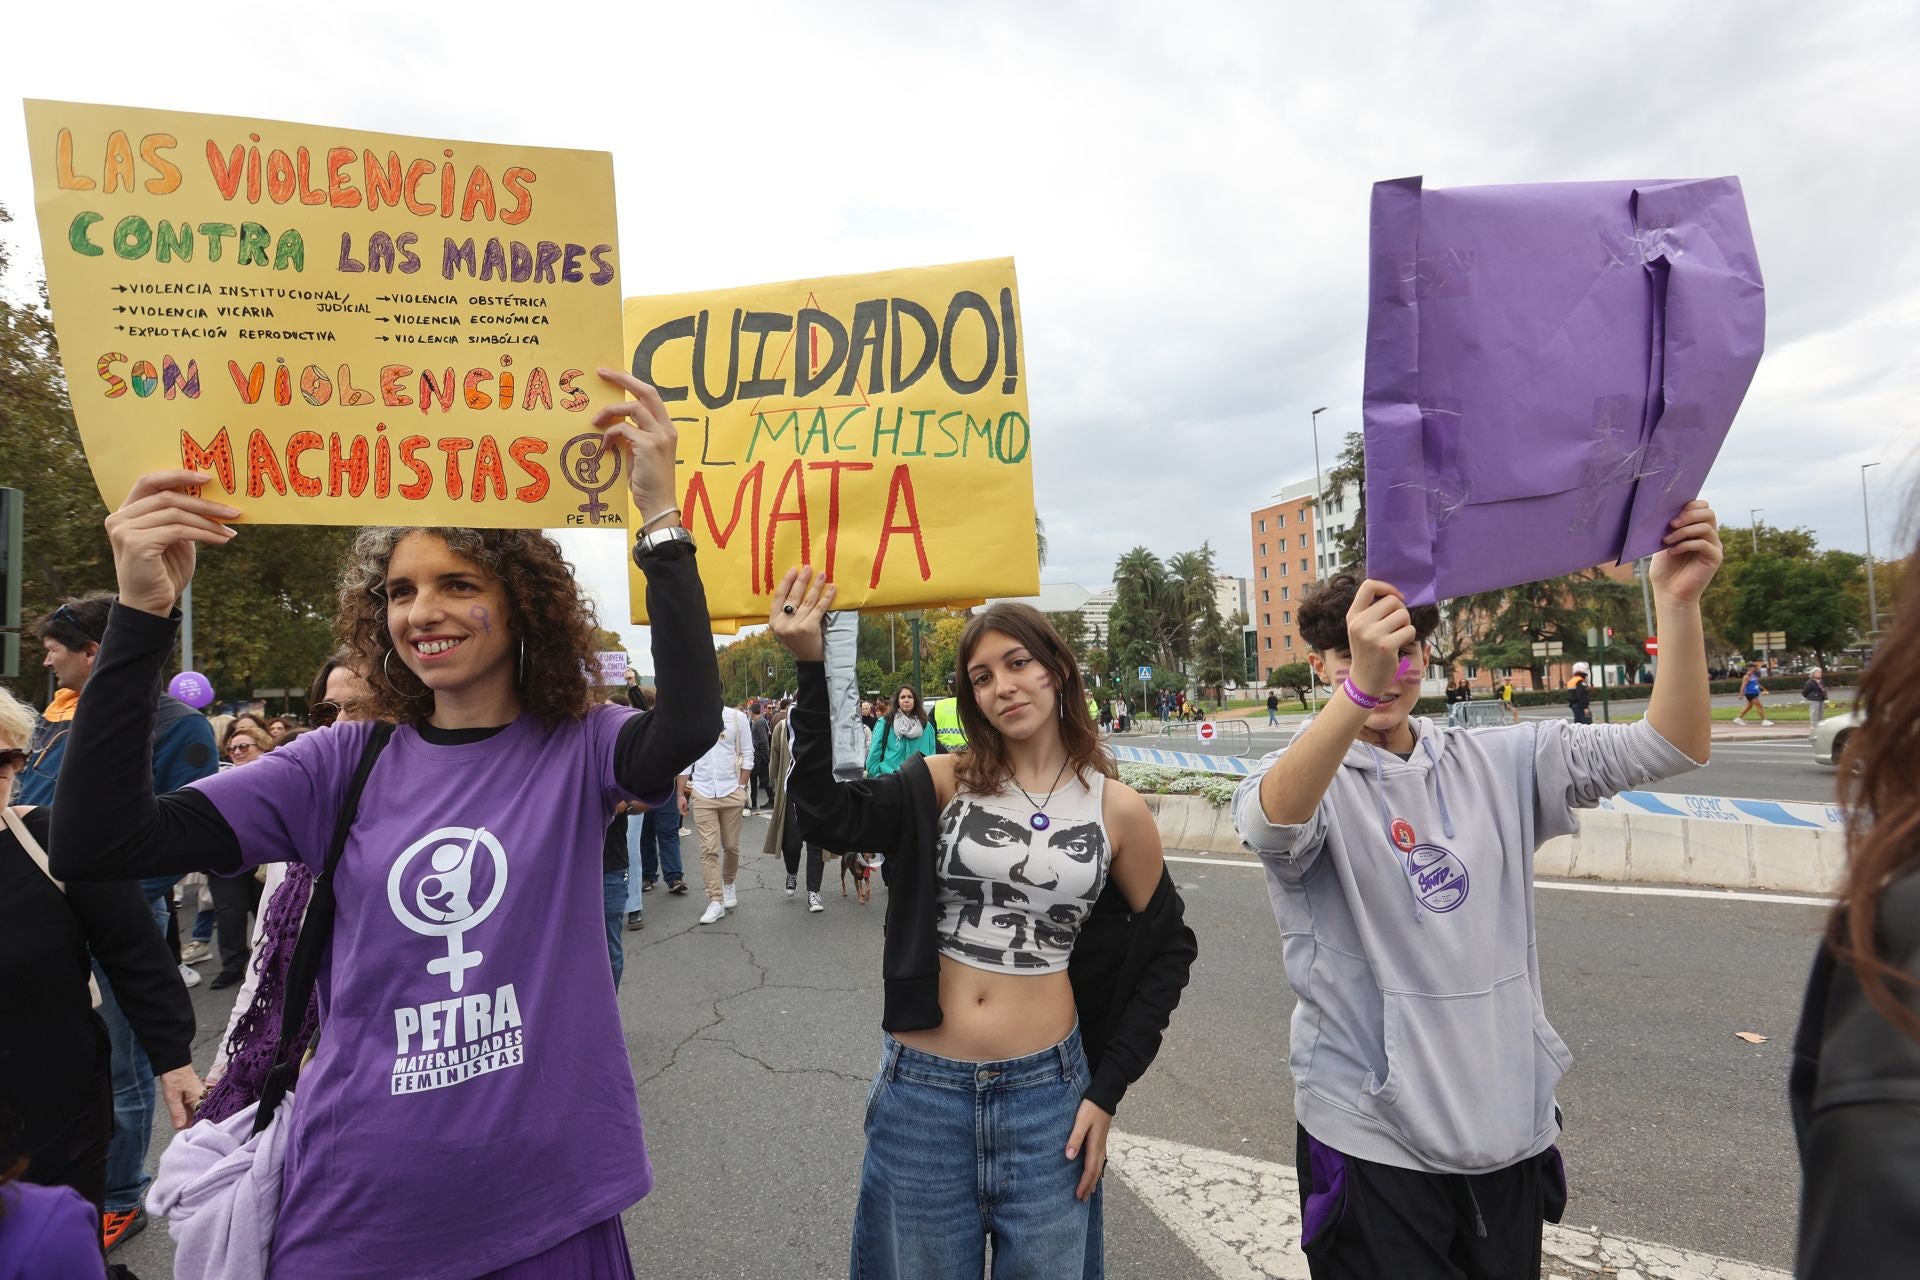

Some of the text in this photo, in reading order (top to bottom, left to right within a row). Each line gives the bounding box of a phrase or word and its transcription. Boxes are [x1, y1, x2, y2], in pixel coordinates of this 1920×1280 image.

[56, 127, 537, 225] LAS VIOLENCIAS
[68, 211, 615, 286] CONTRA LAS MADRES
[129, 283, 213, 296] VIOLENCIA
[129, 305, 275, 319] VIOLENCIA VICARIA
[316, 302, 372, 314] JUDICIAL
[392, 293, 548, 308] VIOLENCIA OBSTÉTRICA
[239, 328, 337, 342] REPRODUCTIVA
[393, 311, 550, 326] VIOLENCIA ECONÓMICA
[395, 331, 540, 346] VIOLENCIA SIMBÓLICA
[631, 286, 1018, 409] CUIDADO!
[96, 351, 592, 415] SON VIOLENCIAS
[745, 405, 1031, 464] MACHISMO
[180, 421, 552, 504] MACHISTAS
[680, 458, 932, 597] MATA
[394, 983, 522, 1055] PETRA
[392, 1029, 523, 1075] MATERNIDADES
[394, 1047, 521, 1093] FEMINISTAS
